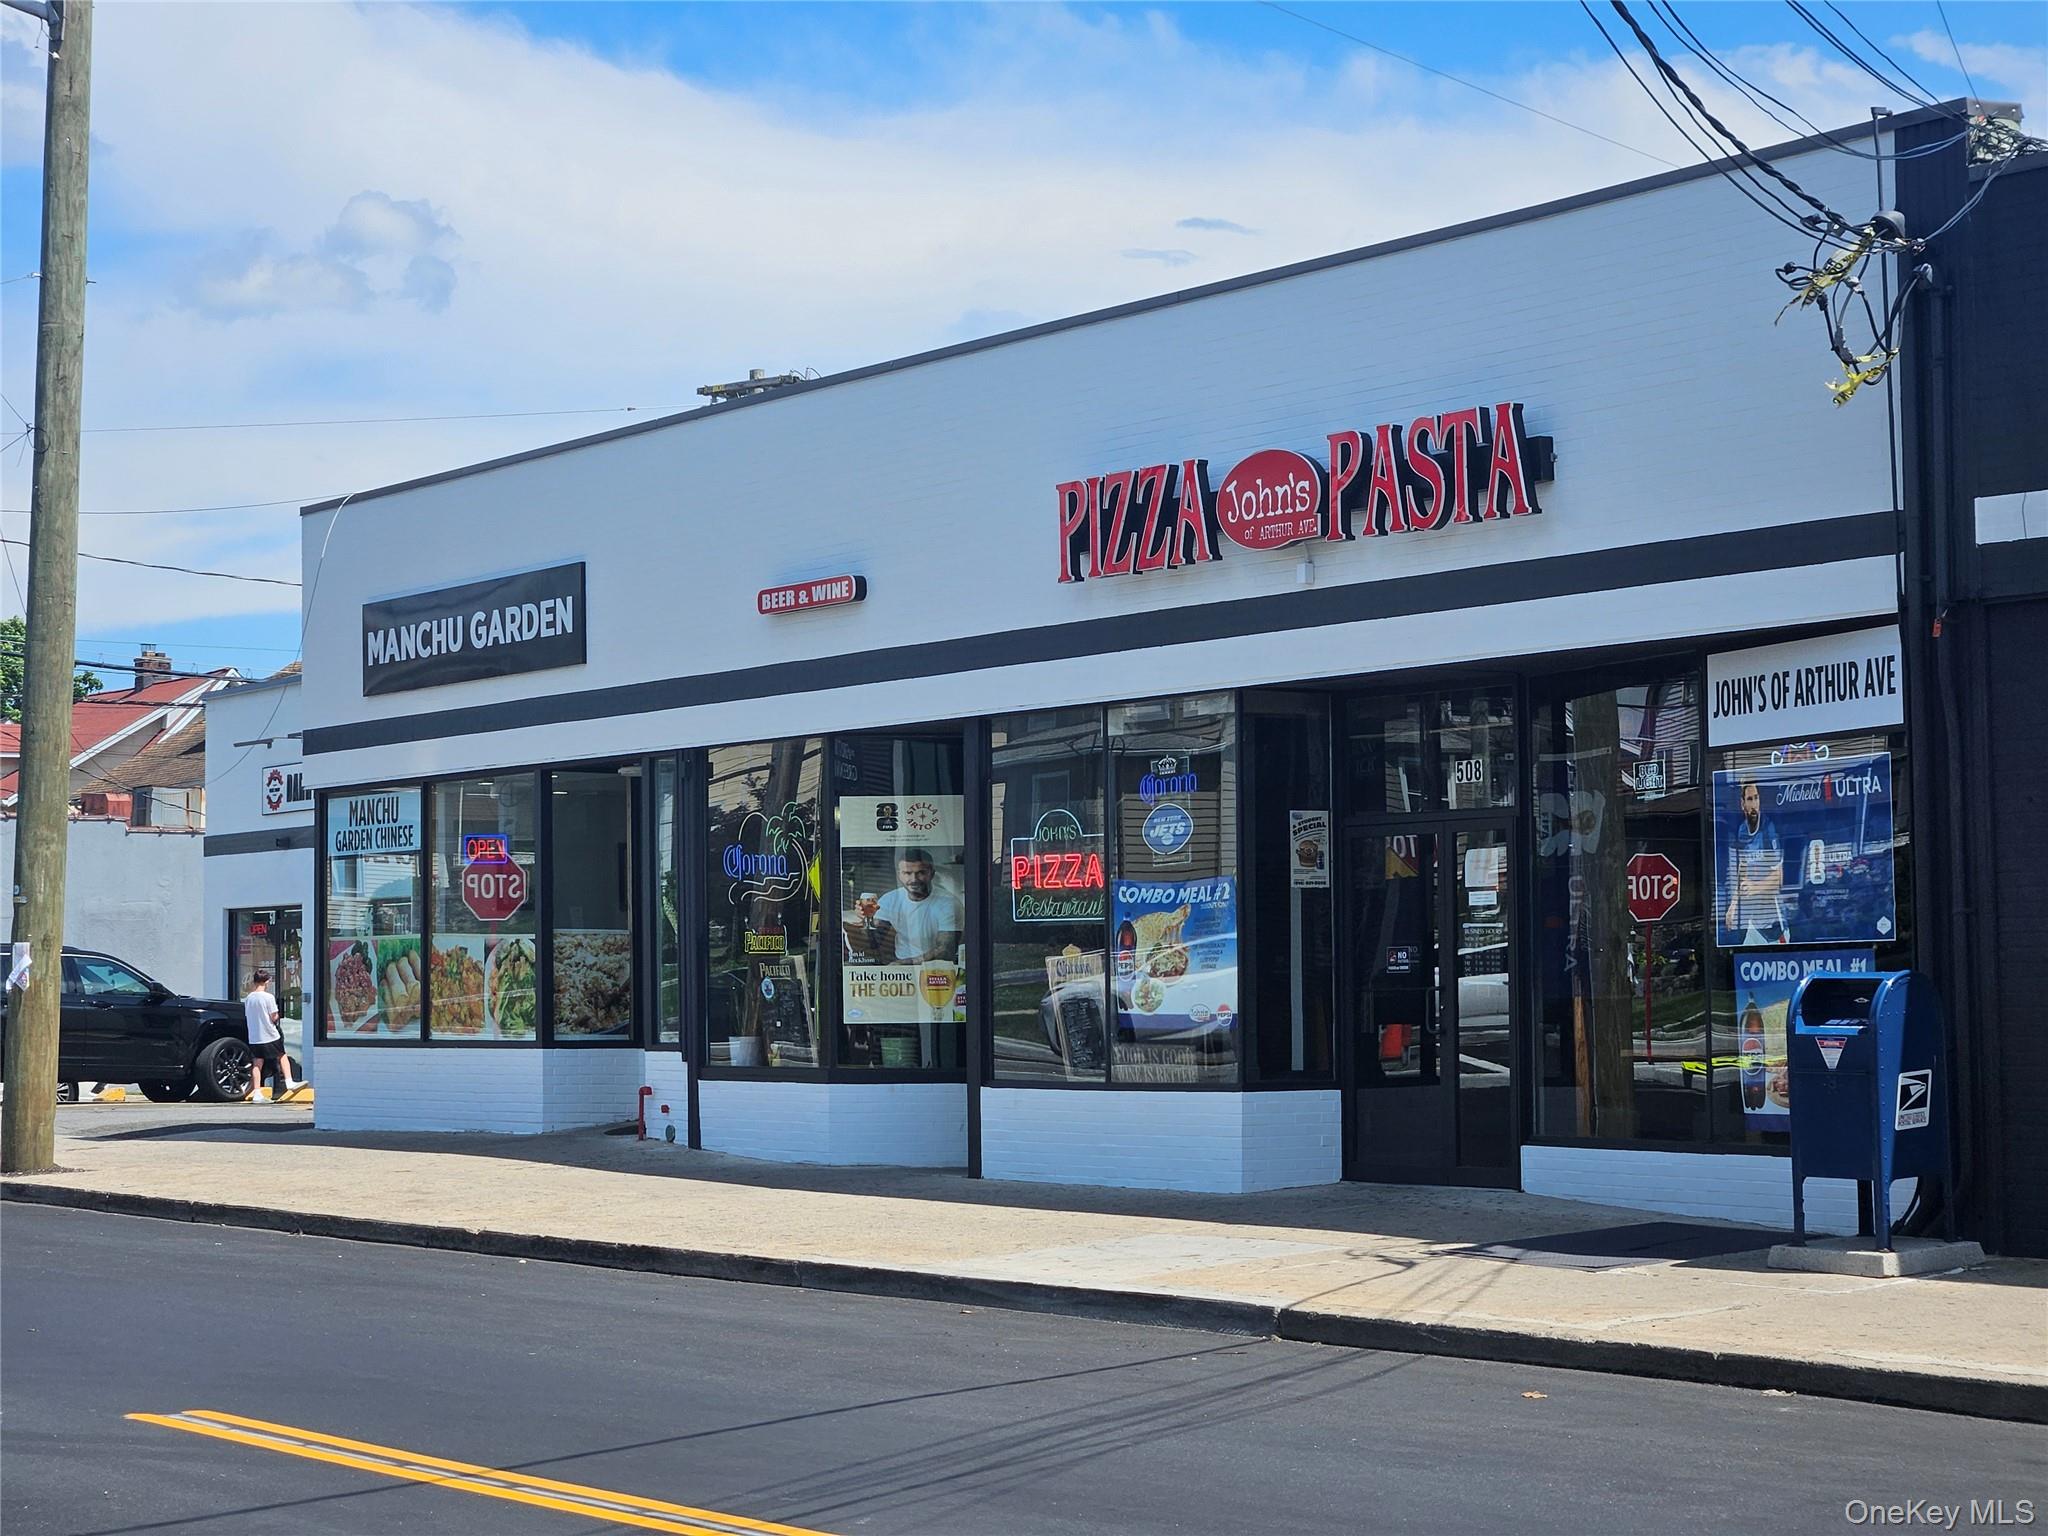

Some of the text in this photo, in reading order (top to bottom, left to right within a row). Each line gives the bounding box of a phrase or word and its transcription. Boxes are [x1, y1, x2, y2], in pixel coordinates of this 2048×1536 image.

[1055, 402, 1535, 583] PIZZA PASTA
[1226, 471, 1310, 523] John's
[1244, 518, 1317, 540] of ARTHUR AVE.
[761, 580, 849, 610] BEER & WINE
[367, 595, 574, 667] MANCHU GARDEN
[1713, 654, 1897, 719] JOHN'S OF ARTHUR AVE
[1456, 760, 1483, 783] 508
[1638, 764, 1660, 778] BUD
[1140, 773, 1197, 806] Corona
[1635, 775, 1665, 791] LIGHT
[1776, 776, 1882, 805] Michelob ULTRA
[349, 795, 400, 828] MANCHU
[906, 802, 939, 816] STELLA
[906, 816, 940, 831] ARTOIS
[1149, 821, 1186, 838] JETS
[1292, 820, 1327, 836] SPECIAL
[335, 825, 414, 852] GARDEN CHINESE
[466, 838, 506, 860] OPEN
[723, 844, 788, 880] Corona
[1012, 853, 1104, 890] PIZZA
[1118, 882, 1231, 904] COMBO MEAL #2
[1016, 894, 1105, 918] Restaurant
[744, 931, 785, 953] PACIFICO
[1397, 951, 1408, 959] NO
[759, 962, 791, 978] PACIFICO
[848, 970, 912, 982] Take home
[1740, 960, 1800, 982] COMBO
[1850, 957, 1868, 972] #1
[848, 982, 916, 998] THE GOLD
[1147, 1047, 1159, 1064] IS
